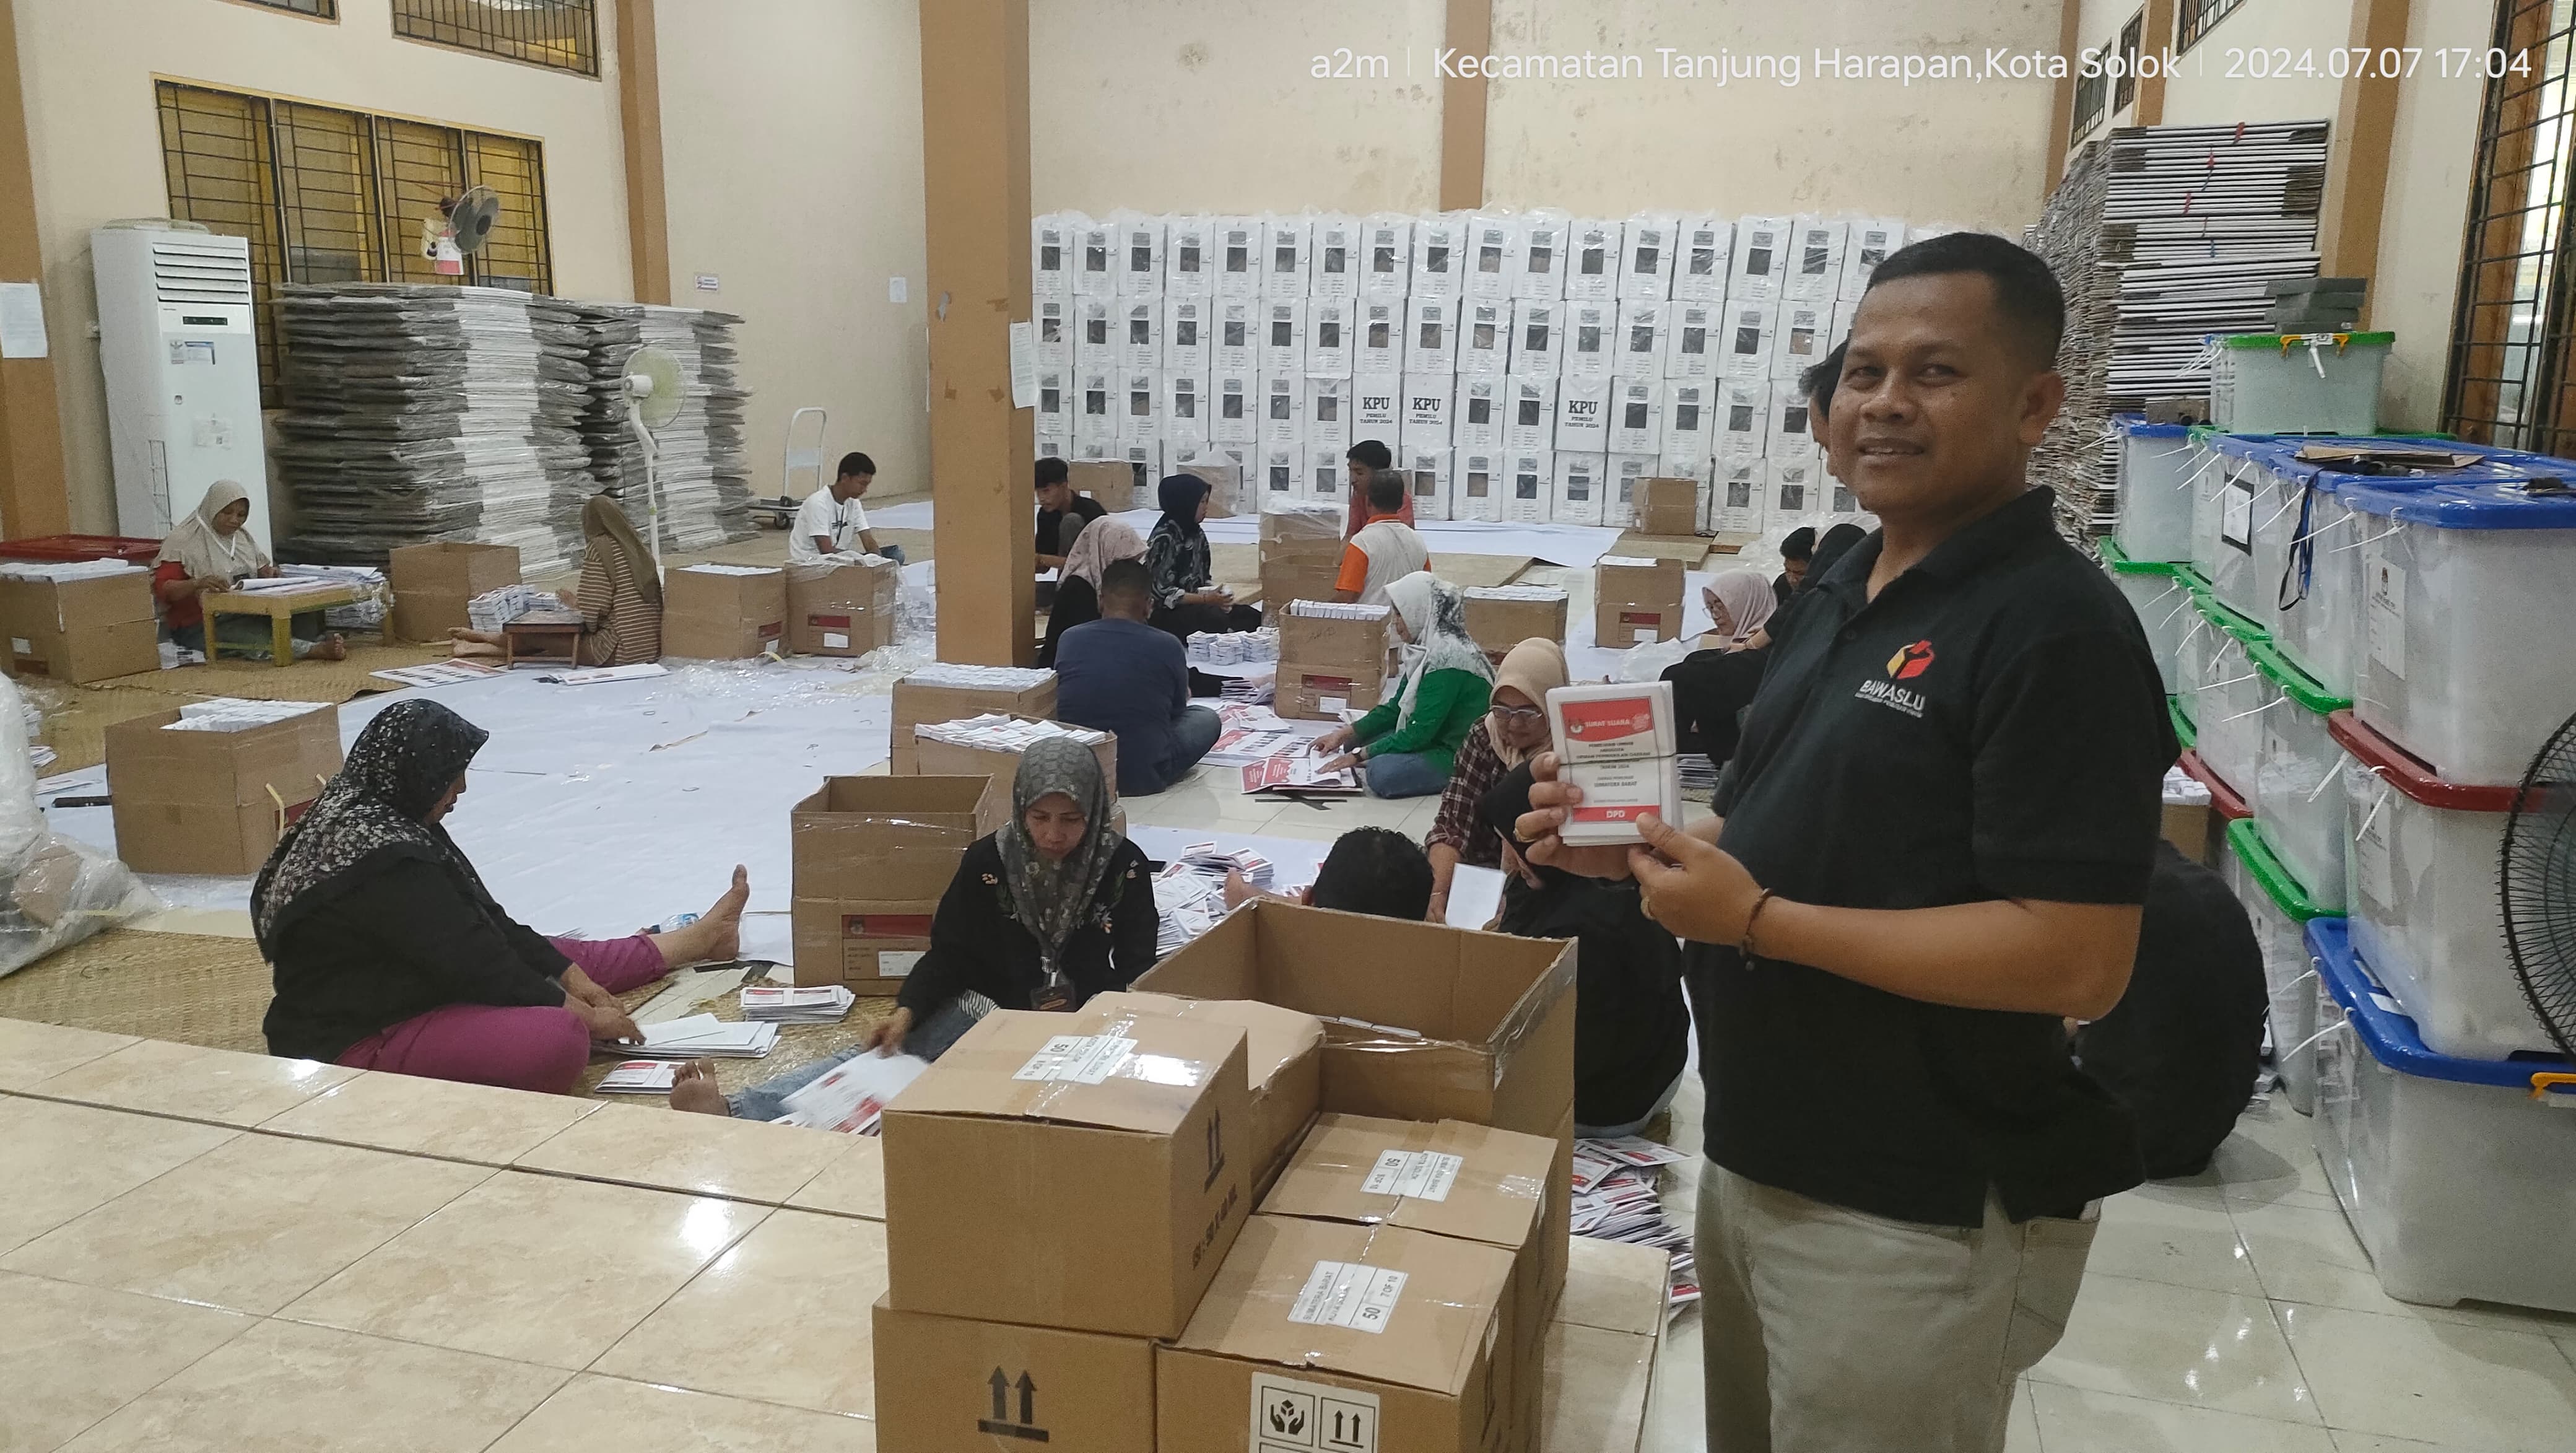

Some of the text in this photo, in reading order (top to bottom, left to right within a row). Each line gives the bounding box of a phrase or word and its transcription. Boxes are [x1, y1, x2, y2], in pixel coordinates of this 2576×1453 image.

[1362, 397, 1390, 409] KPU
[1412, 398, 1442, 411] KPU
[1569, 400, 1598, 414] KPU
[1859, 679, 1926, 710] BAWASLU
[1606, 810, 1625, 818] DPD
[1050, 1044, 1069, 1052] 50
[1385, 1158, 1400, 1166] 50
[1382, 1283, 1394, 1293] OF
[1362, 1307, 1380, 1319] 50
